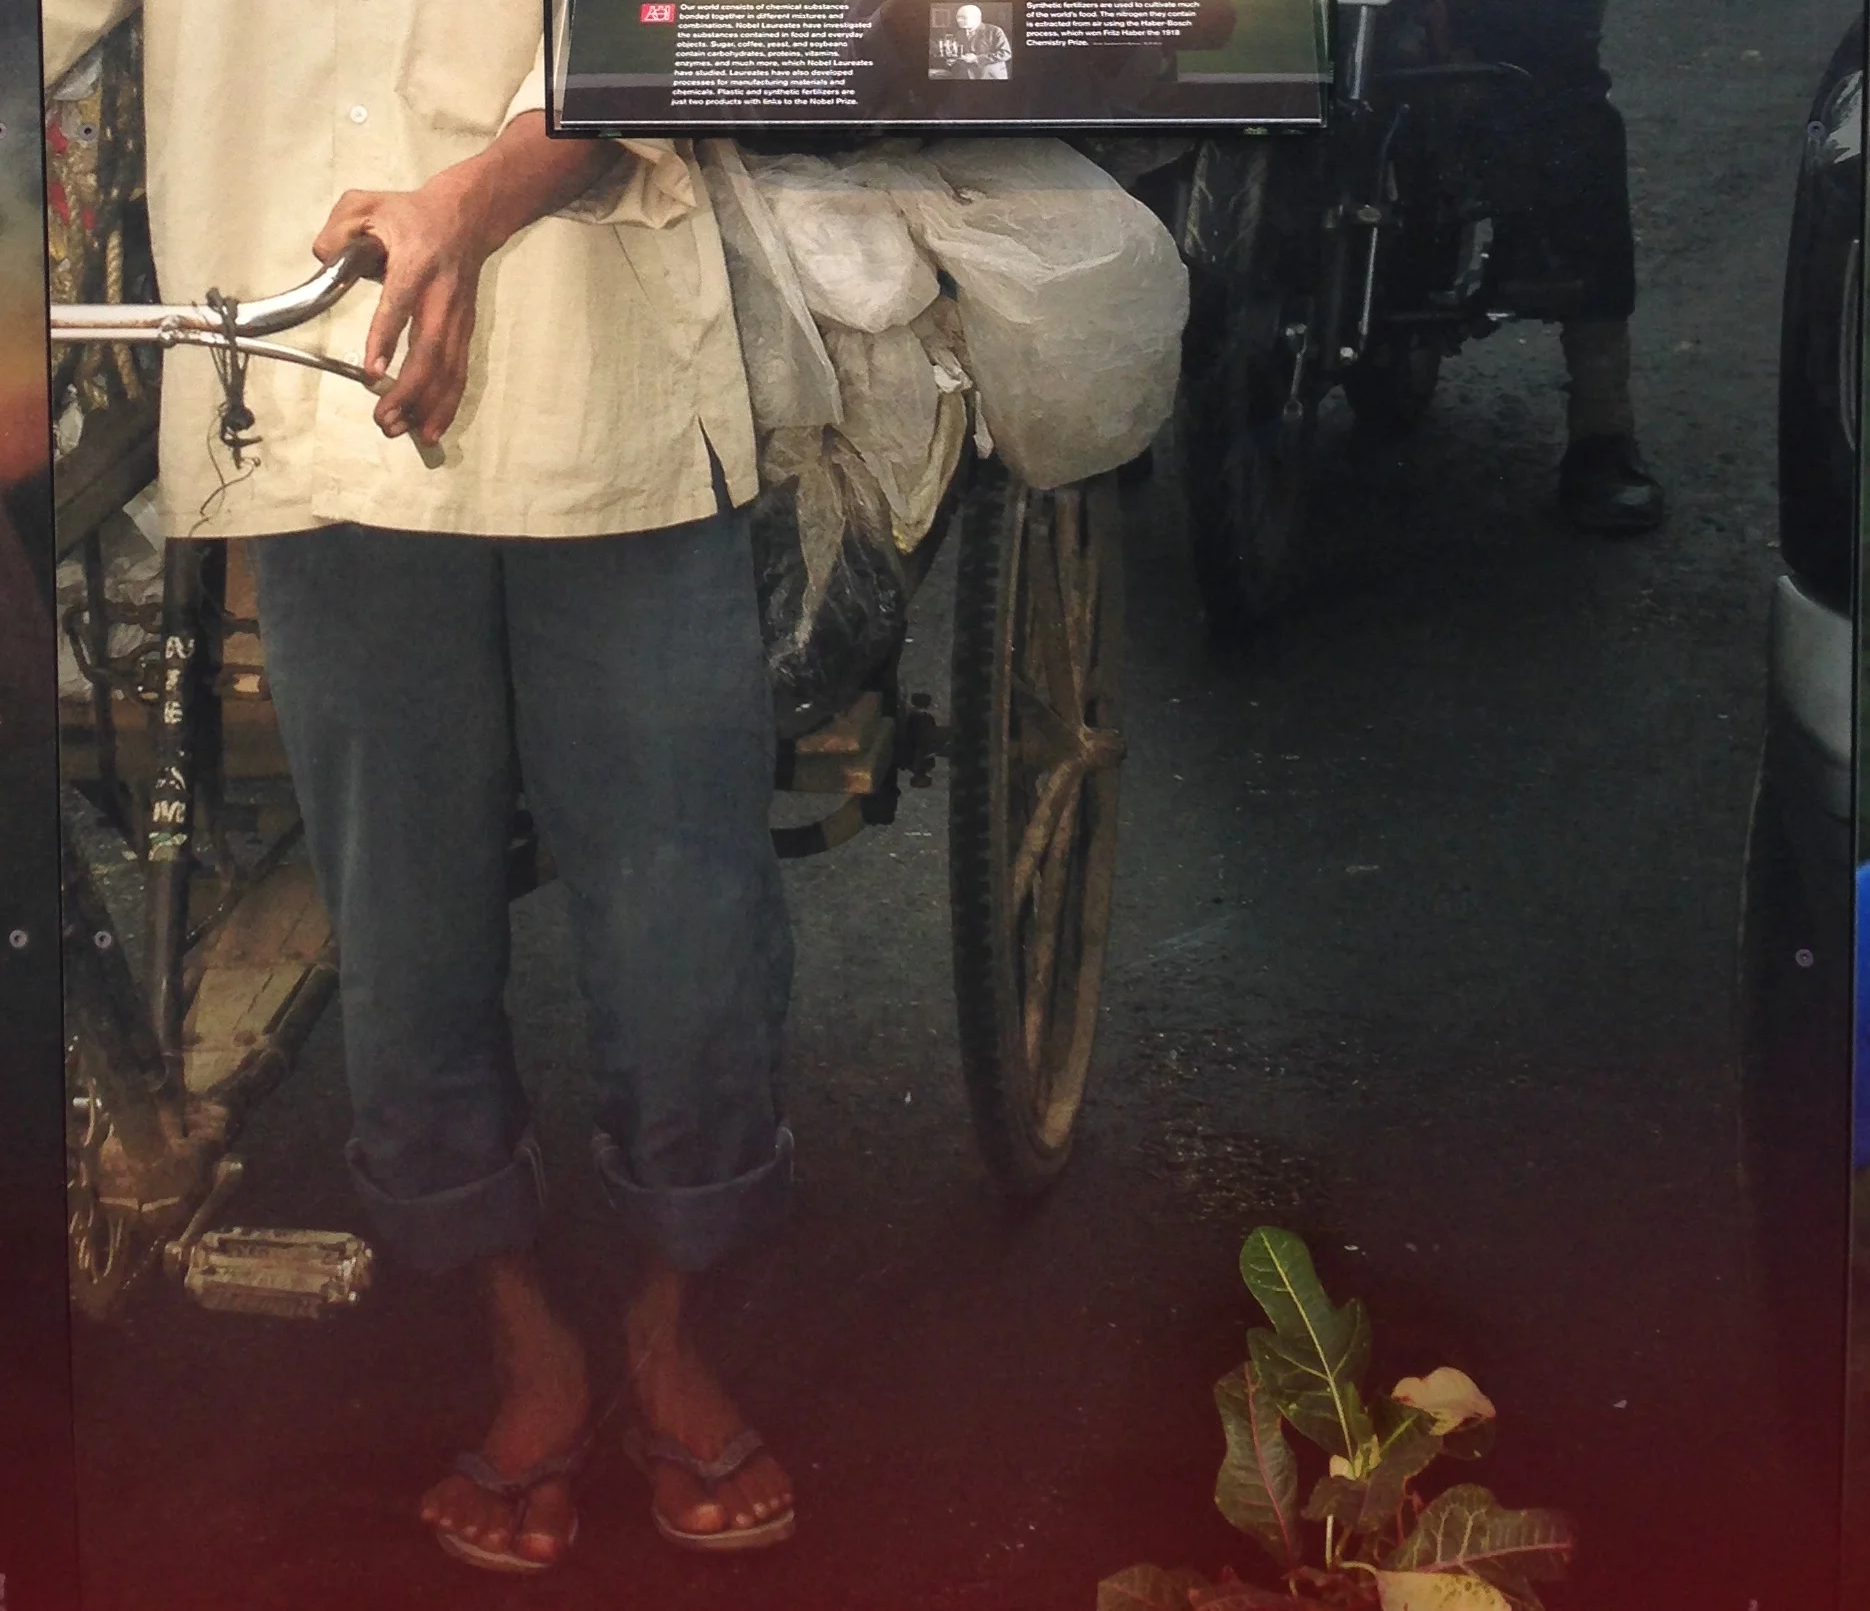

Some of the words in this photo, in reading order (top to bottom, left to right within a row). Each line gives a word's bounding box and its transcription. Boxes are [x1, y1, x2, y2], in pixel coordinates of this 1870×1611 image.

[681, 3, 694, 11] Our
[698, 3, 719, 11] world
[766, 3, 801, 11] chemical
[804, 3, 849, 11] substances
[1027, 1, 1060, 10] Synthetic
[1064, 1, 1098, 9] fertilizers
[1115, 1, 1133, 9] used
[1145, 1, 1175, 9] cultivate
[1178, 1, 1199, 9] much
[712, 13, 745, 21] together
[1036, 11, 1048, 19] the
[1101, 11, 1114, 19] The
[1116, 11, 1147, 20] nitrogen
[1150, 11, 1165, 20] they
[1168, 11, 1195, 19] contain
[736, 22, 759, 30] Nobel
[762, 22, 800, 30] Laureates
[803, 22, 821, 30] have
[824, 22, 871, 31] investigated
[1104, 20, 1124, 28] using
[678, 31, 690, 39] the
[693, 31, 738, 39] substances
[740, 31, 779, 39] contained
[791, 31, 809, 39] food
[811, 31, 826, 39] and
[828, 31, 863, 40] everyday
[1061, 29, 1083, 37] which
[1122, 29, 1144, 37] Haber
[1147, 29, 1160, 37] the
[793, 40, 807, 48] and
[1026, 39, 1065, 48] Chemistry
[676, 49, 705, 58] contain
[715, 59, 730, 67] and
[732, 59, 754, 67] much
[782, 59, 805, 67] which
[808, 59, 831, 67] Nobel
[834, 59, 873, 67] Laureates
[811, 69, 853, 77] developed
[673, 79, 714, 87] processes
[718, 78, 727, 86] for
[731, 78, 788, 87] manufacturing
[791, 78, 827, 86] materials
[830, 78, 845, 86] and
[718, 87, 743, 95] Plastic
[746, 87, 761, 95] and
[764, 87, 799, 96] synthetic
[802, 87, 839, 95] fertilizers
[672, 97, 686, 106] just
[689, 97, 703, 105] two
[706, 97, 741, 106] products
[744, 97, 761, 105] with
[794, 97, 807, 105] the
[810, 97, 834, 105] Nobel
